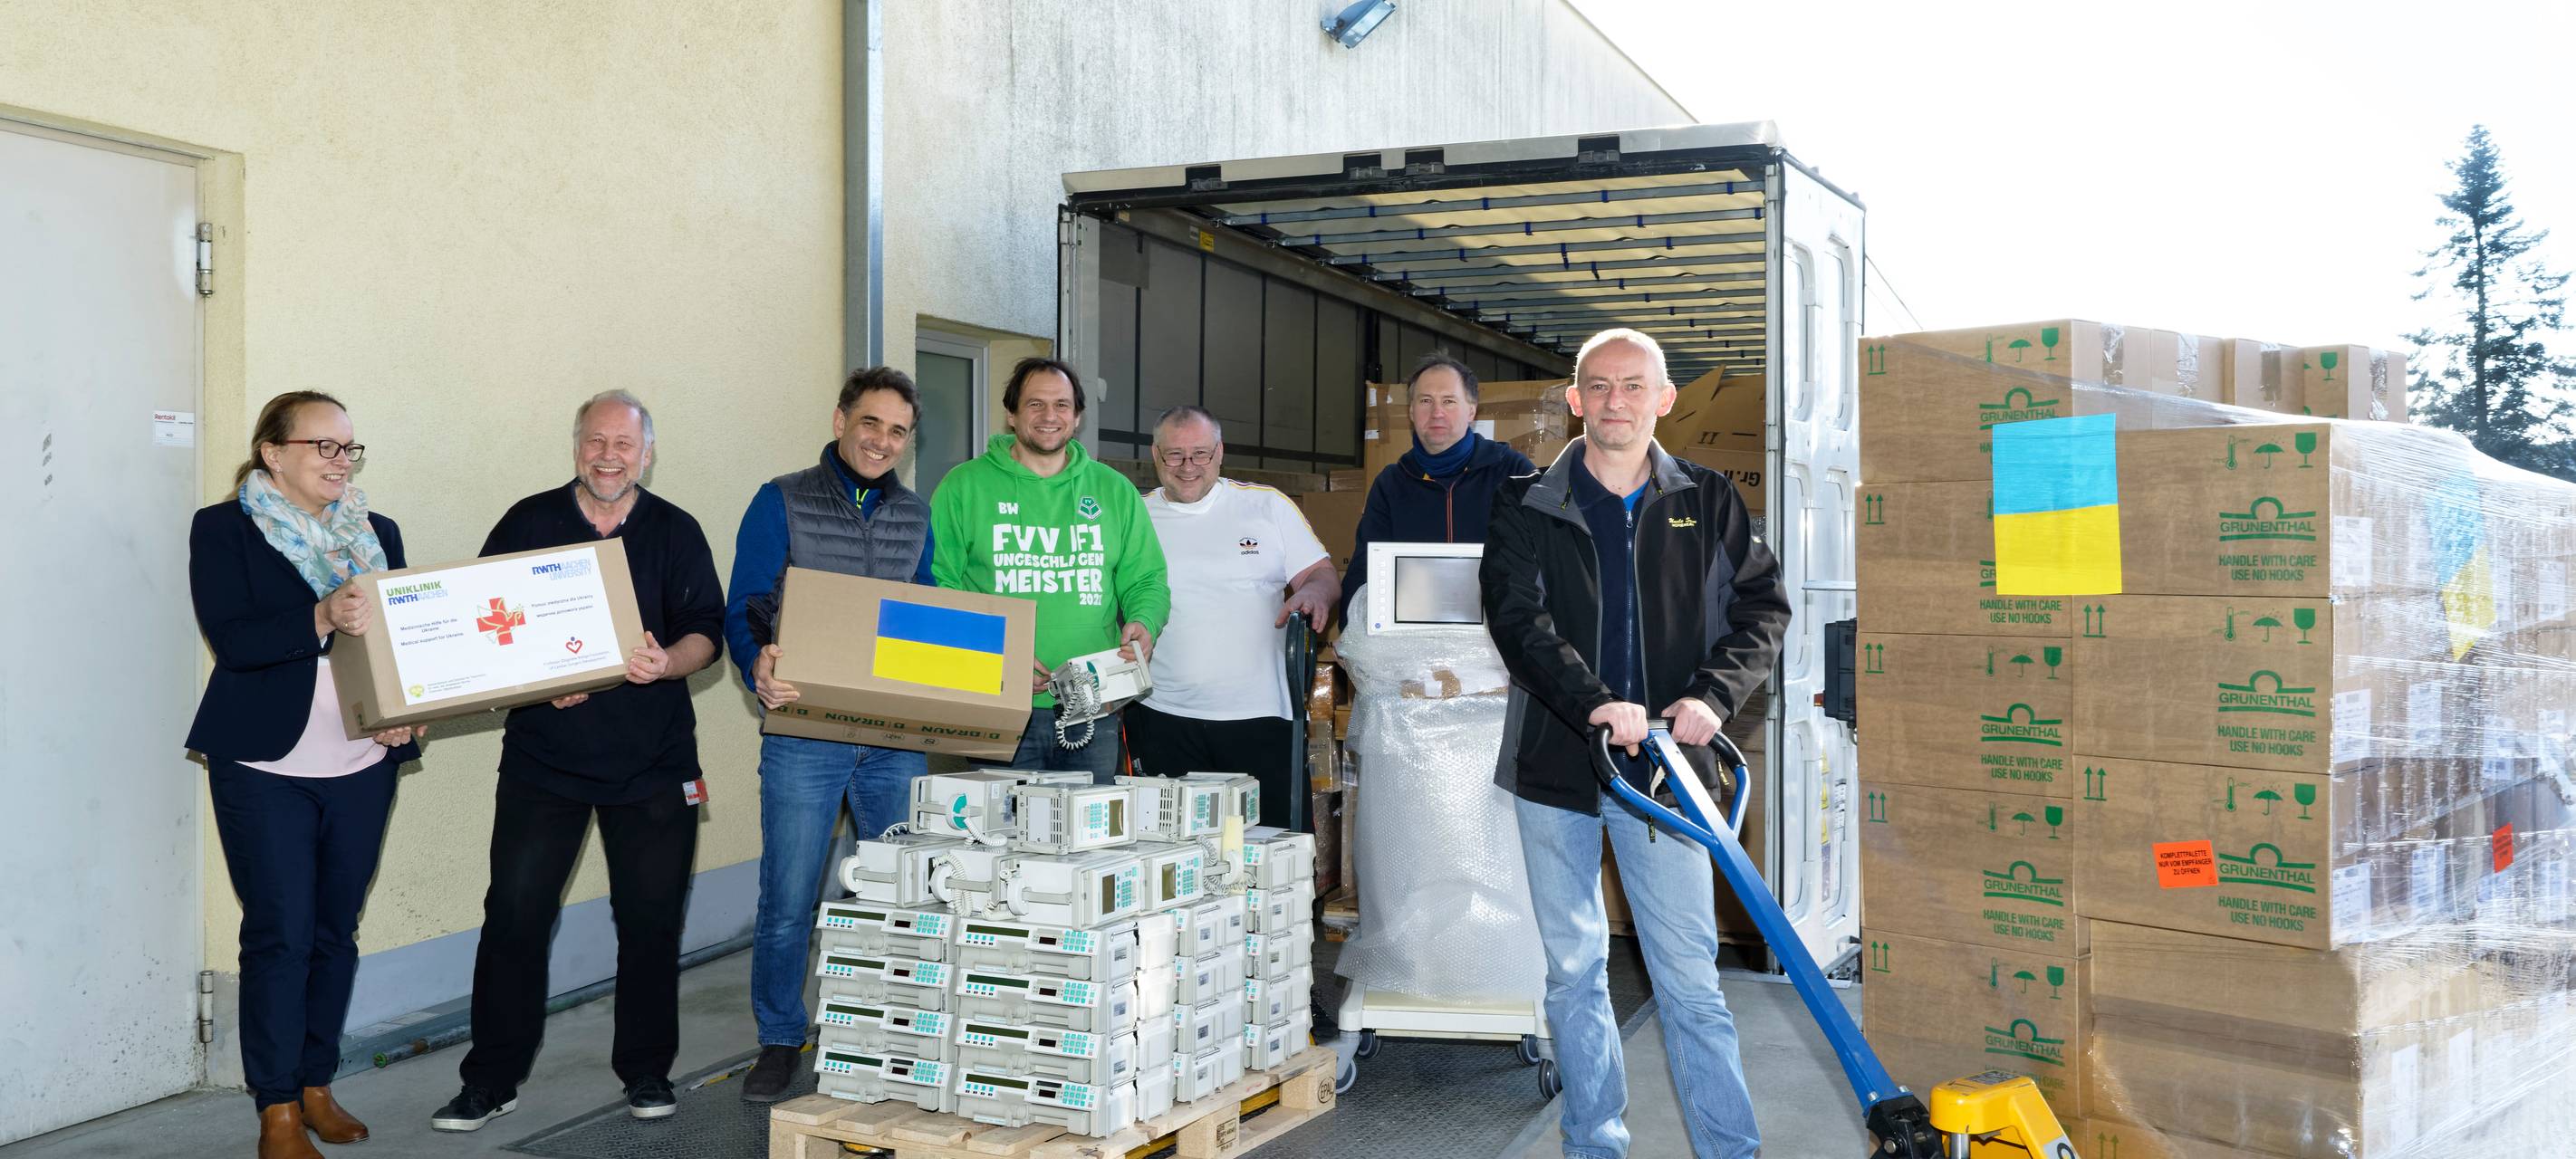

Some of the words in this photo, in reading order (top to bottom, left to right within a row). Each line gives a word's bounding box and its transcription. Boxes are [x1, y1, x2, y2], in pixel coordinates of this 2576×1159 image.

[998, 502, 1018, 515] BW
[993, 523, 1060, 553] FVV
[2219, 555, 2258, 567] HANDLE
[2261, 555, 2286, 567] WITH
[2289, 555, 2317, 567] CARE
[995, 568, 1103, 593] MEISTER
[2231, 569, 2250, 580] USE
[2252, 569, 2266, 580] NO
[2269, 569, 2304, 580] HOOKS
[386, 580, 442, 597] UNIKLINIK
[1980, 599, 2013, 610] HANDLE
[2015, 599, 2036, 610] WITH
[2039, 600, 2062, 611] CARE
[1990, 612, 2006, 623] USE
[2008, 612, 2021, 623] NO
[2022, 613, 2052, 624] HOOKS
[2217, 725, 2258, 739] HANDLE
[2260, 728, 2286, 741] WITH
[2288, 730, 2317, 742] CARE
[2230, 740, 2249, 752] USE
[2251, 742, 2266, 754] NO
[2268, 742, 2304, 757] HOOKS
[1981, 754, 2014, 767] HANDLE
[2016, 757, 2037, 769] WITH
[2040, 758, 2063, 771] CARE
[1991, 768, 2007, 779] USE
[2009, 769, 2022, 780] NO
[2023, 770, 2053, 782] HOOKS
[2218, 896, 2259, 912] HANDLE
[2260, 900, 2286, 915] WITH
[2288, 905, 2317, 919] CARE
[1983, 909, 2016, 924] HANDLE
[2018, 913, 2039, 926] WITH
[2042, 916, 2064, 930] CARE
[2230, 911, 2250, 924] USE
[2252, 915, 2266, 927] NO
[2268, 917, 2304, 932] HOOKS
[1993, 924, 2010, 935] USE
[2012, 925, 2023, 937] NO
[2025, 927, 2054, 942] HOOKS
[1321, 1082, 1333, 1099] EPAL
